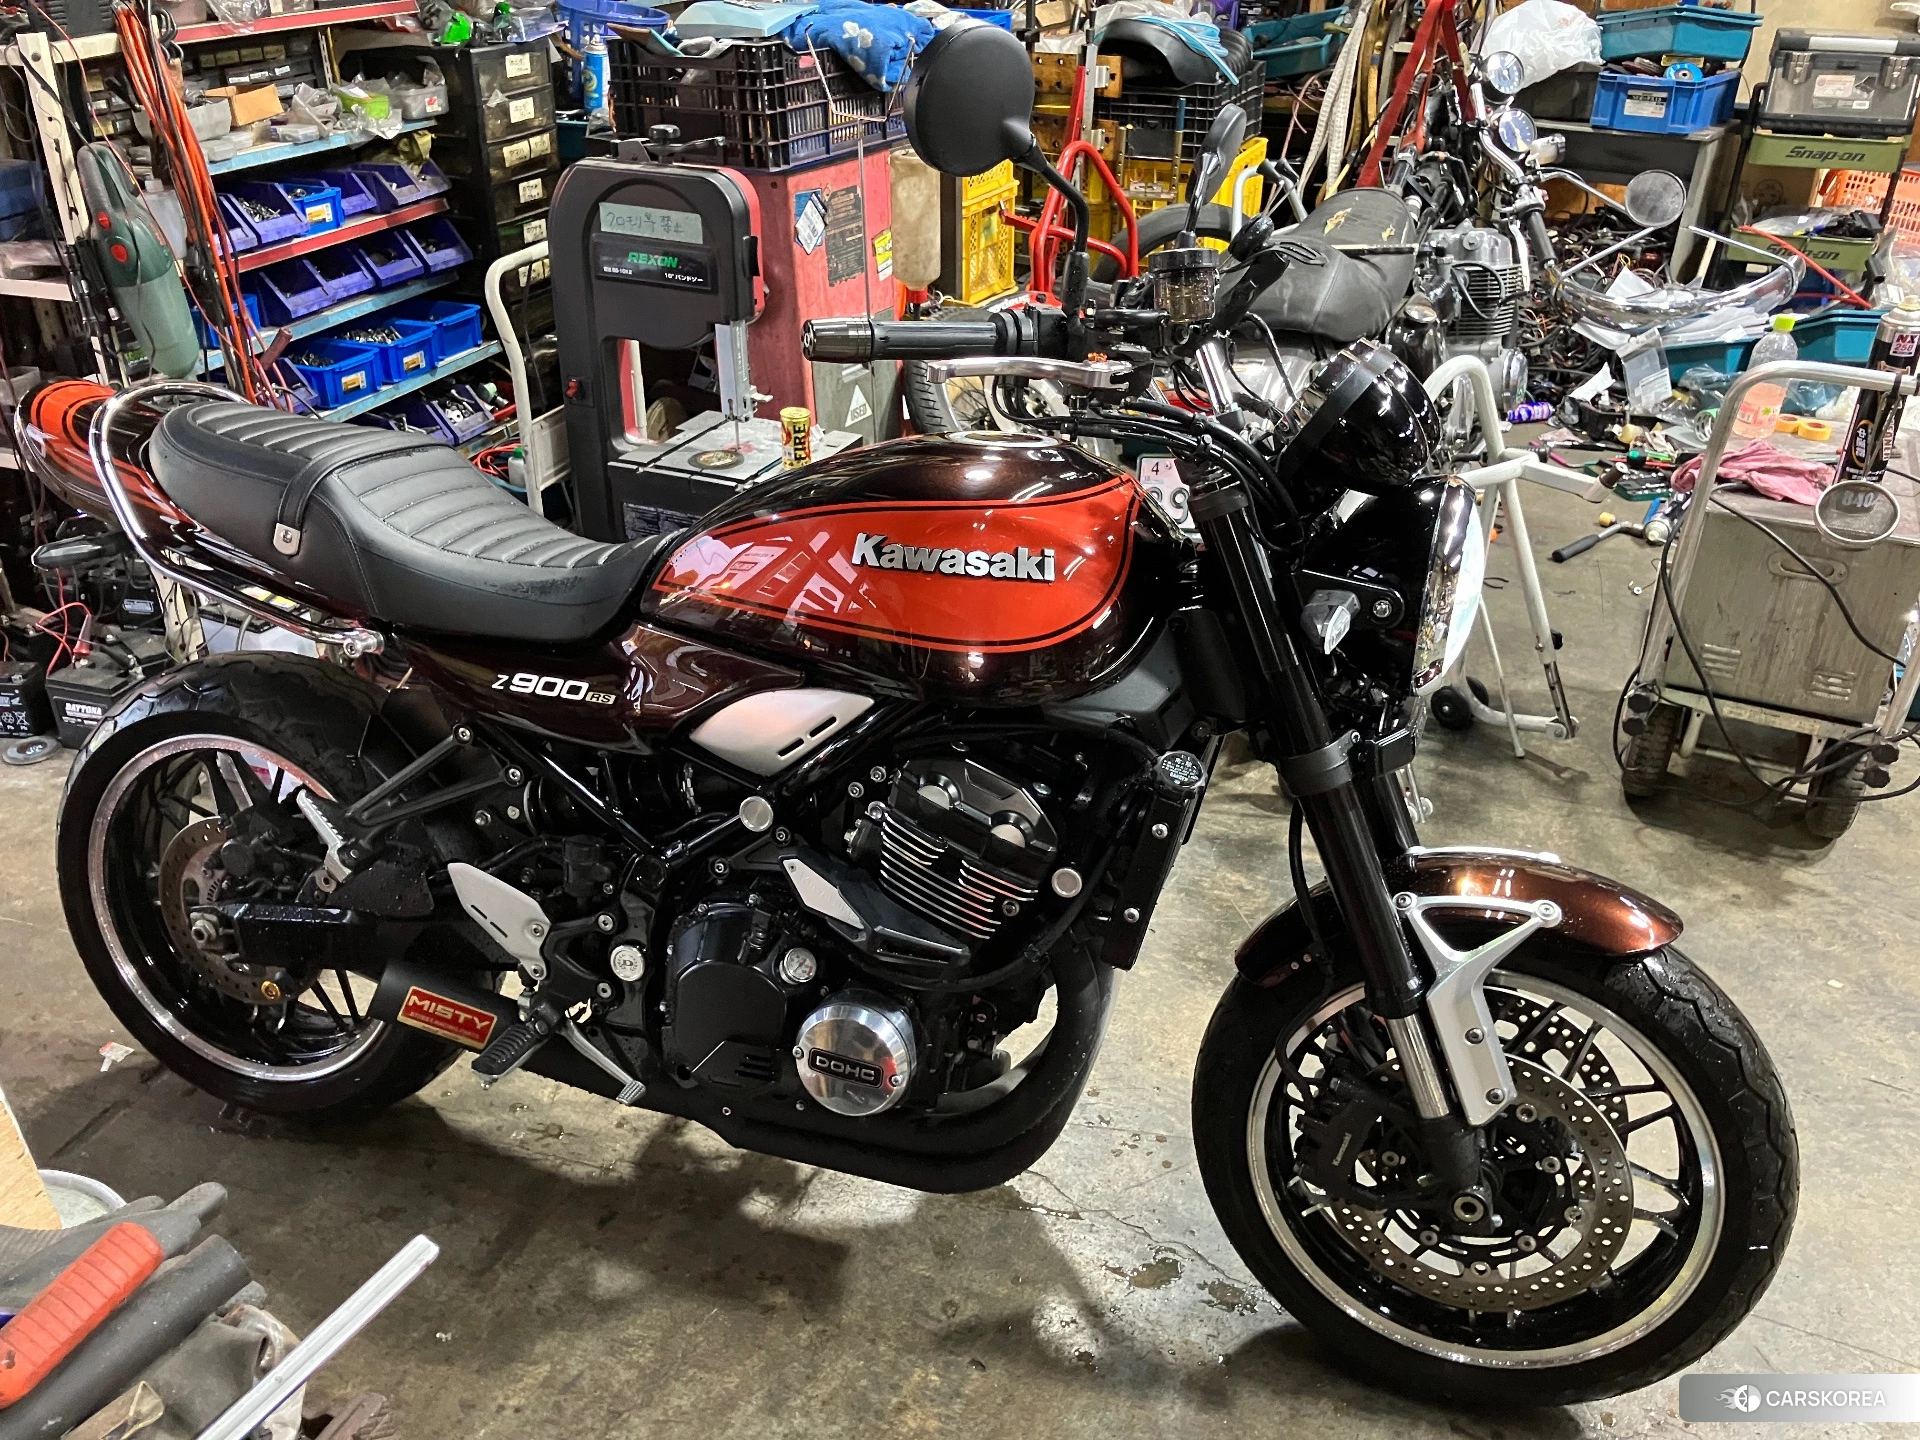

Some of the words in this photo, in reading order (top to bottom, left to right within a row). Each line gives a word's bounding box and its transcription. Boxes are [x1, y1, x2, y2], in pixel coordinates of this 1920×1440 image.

[1785, 145, 1866, 162] Snap-on
[627, 250, 679, 269] REXON
[1896, 334, 1919, 344] NX
[793, 422, 807, 461] FIRE
[1151, 461, 1160, 476] 4
[851, 532, 1056, 583] Kawasaki
[65, 702, 103, 716] DAYTONA
[408, 995, 491, 1030] MISTY
[815, 1055, 875, 1081] DOHC
